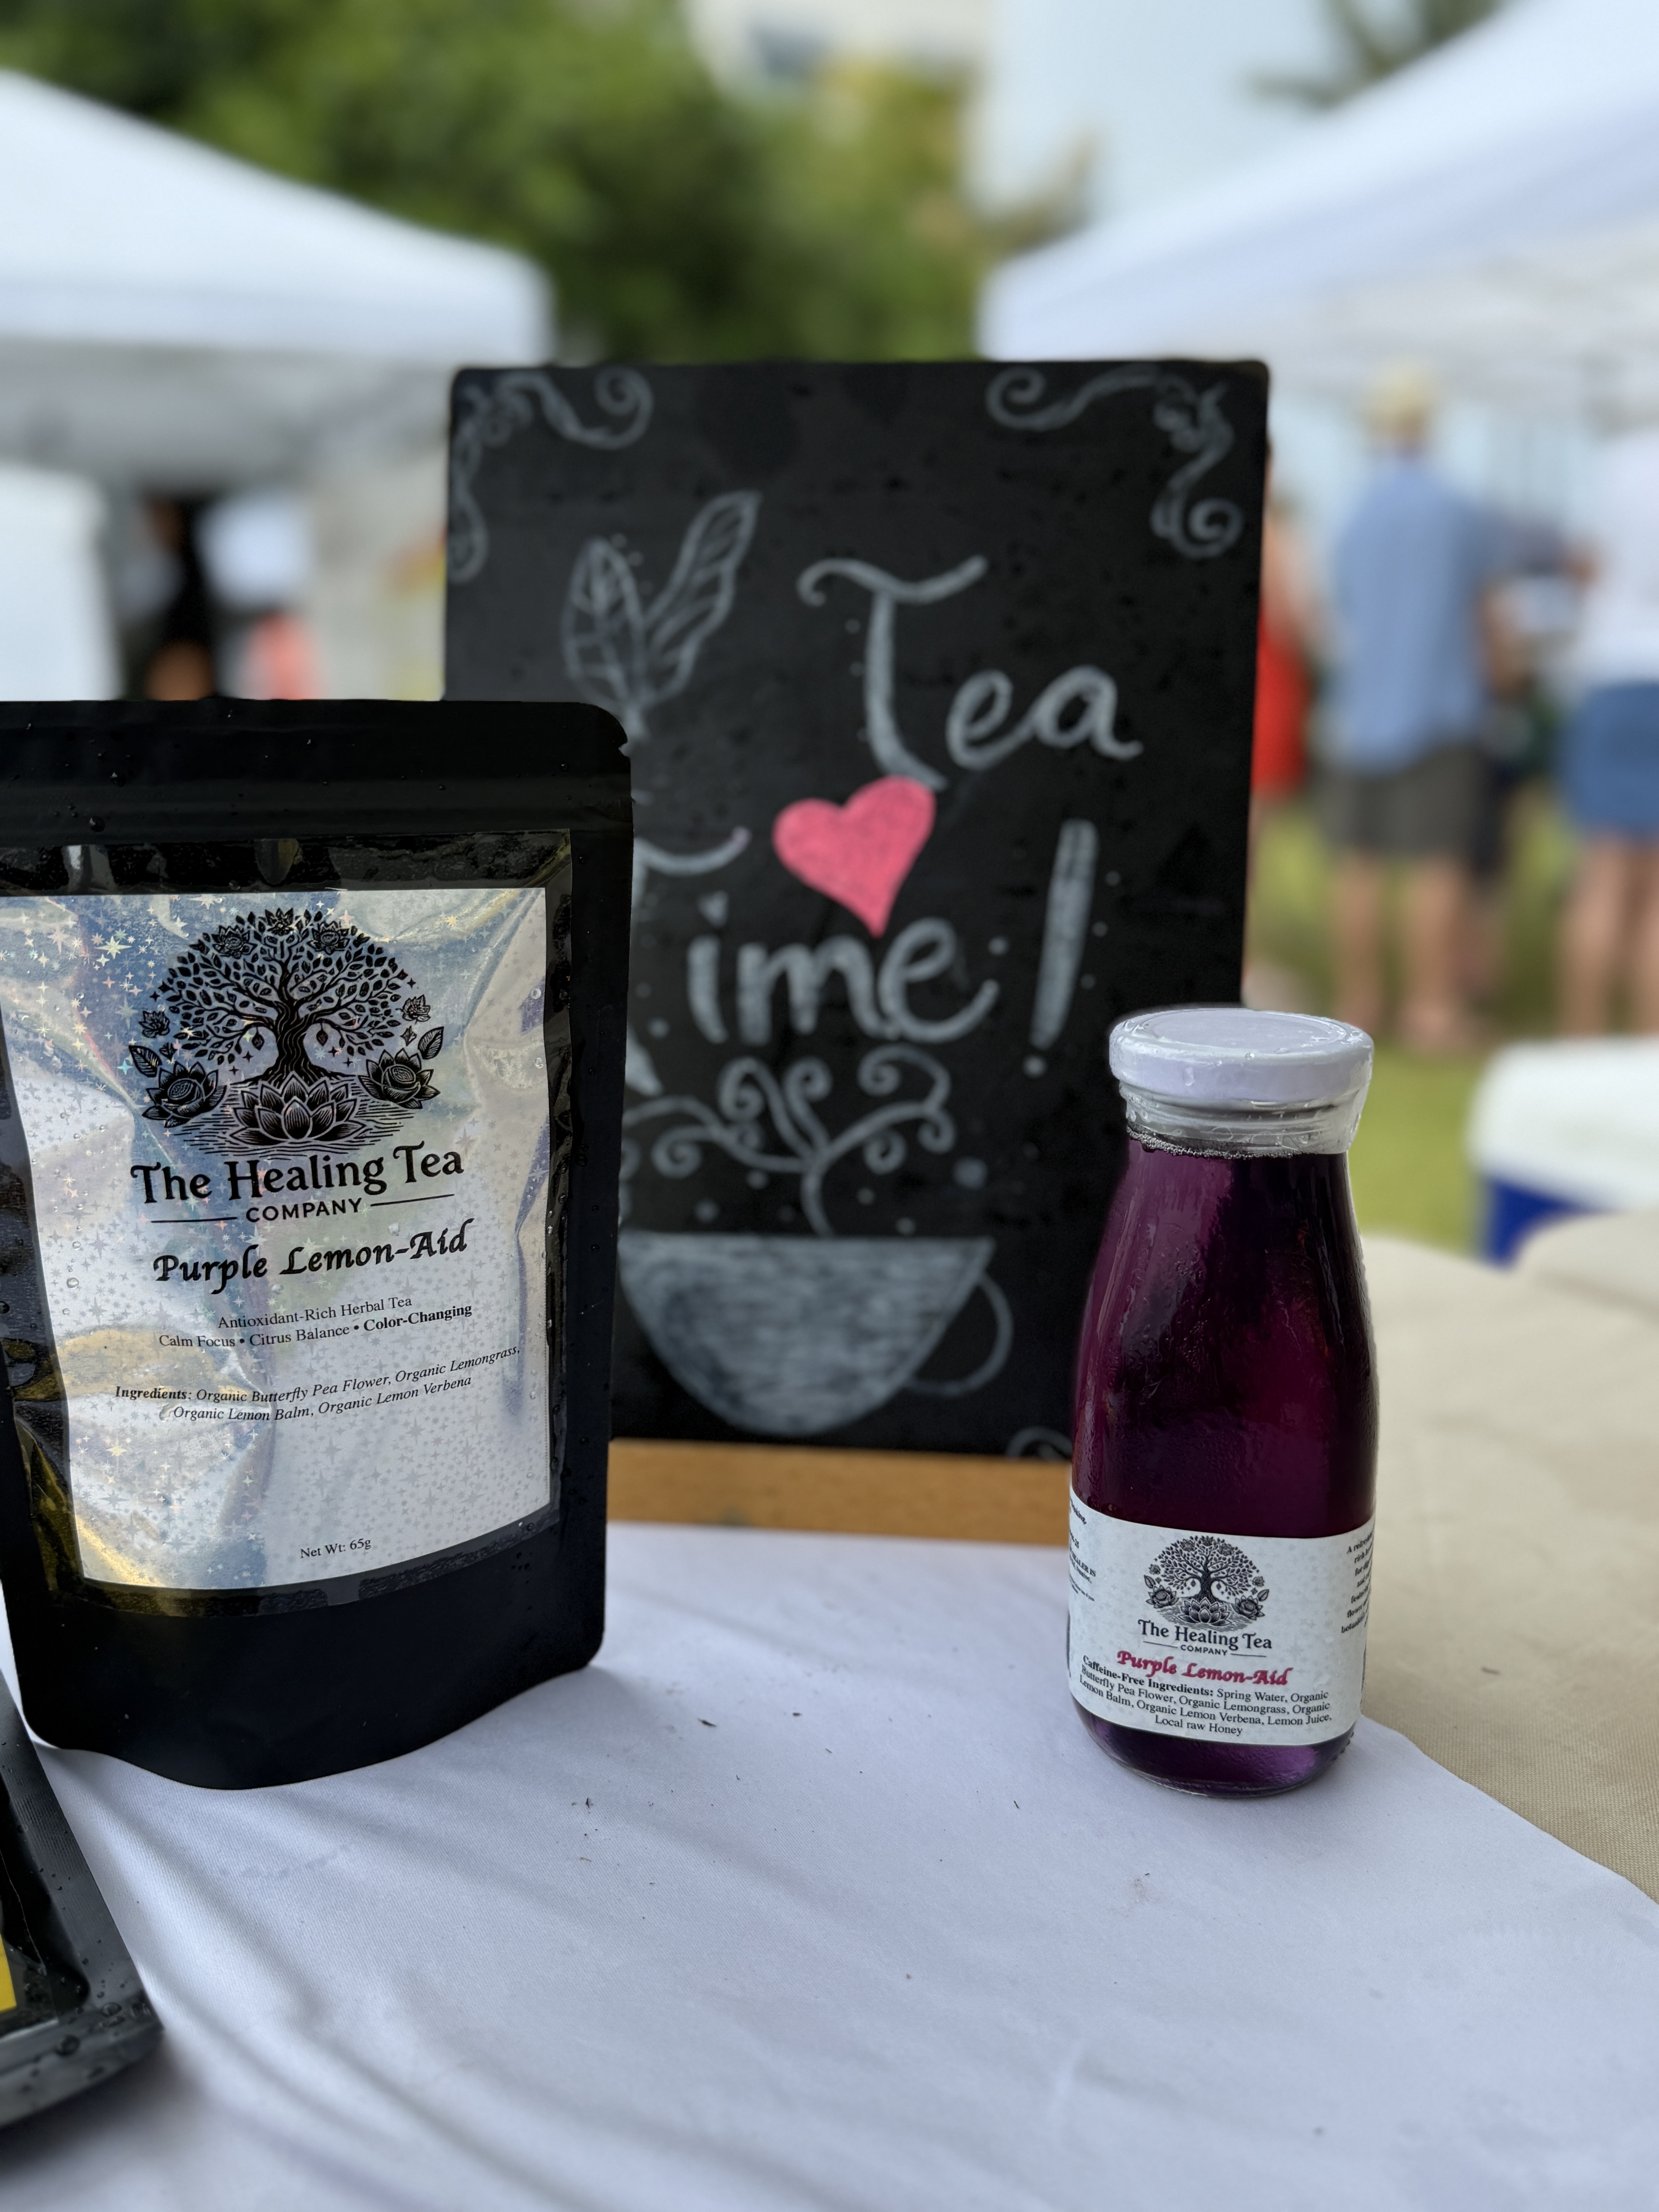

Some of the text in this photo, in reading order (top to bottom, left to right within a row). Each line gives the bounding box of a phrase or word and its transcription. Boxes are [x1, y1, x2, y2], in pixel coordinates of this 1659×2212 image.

[797, 555, 1144, 792] Tea
[130, 1140, 464, 1204] The Healing Tea
[246, 1198, 362, 1223] COMPANY
[153, 1218, 475, 1295] Purple Lemon-Aid
[159, 1305, 472, 1347] Calm Focus Citrus Balance Color-Changing
[218, 1297, 412, 1328] Antioxidant-Rich Herbal Tea
[116, 1346, 520, 1403] Ingredients: Organic Butterfly Pea Flower, Organic Lemongrass,
[174, 1377, 471, 1421] Organic Lemon Balm, Organic Lemon Verbena
[301, 1538, 371, 1559] Net Wt: 65g
[1138, 1619, 1272, 1651] The Healing Tea
[1180, 1644, 1228, 1656] COMPANY
[1083, 1655, 1329, 1704] Caffeine-Free Ingredients: Spring Water, Organic
[1117, 1650, 1293, 1685] Purple Lemon-Aid
[1080, 1674, 1332, 1725] Lemon Balm, Organic Lemon Verbena, Lemon Juice,
[1082, 1664, 1330, 1715] Butterfly Pea Flower, Organic Lemongrass, Organic
[1155, 1715, 1183, 1728] Local
[1209, 1723, 1243, 1736] Honey
